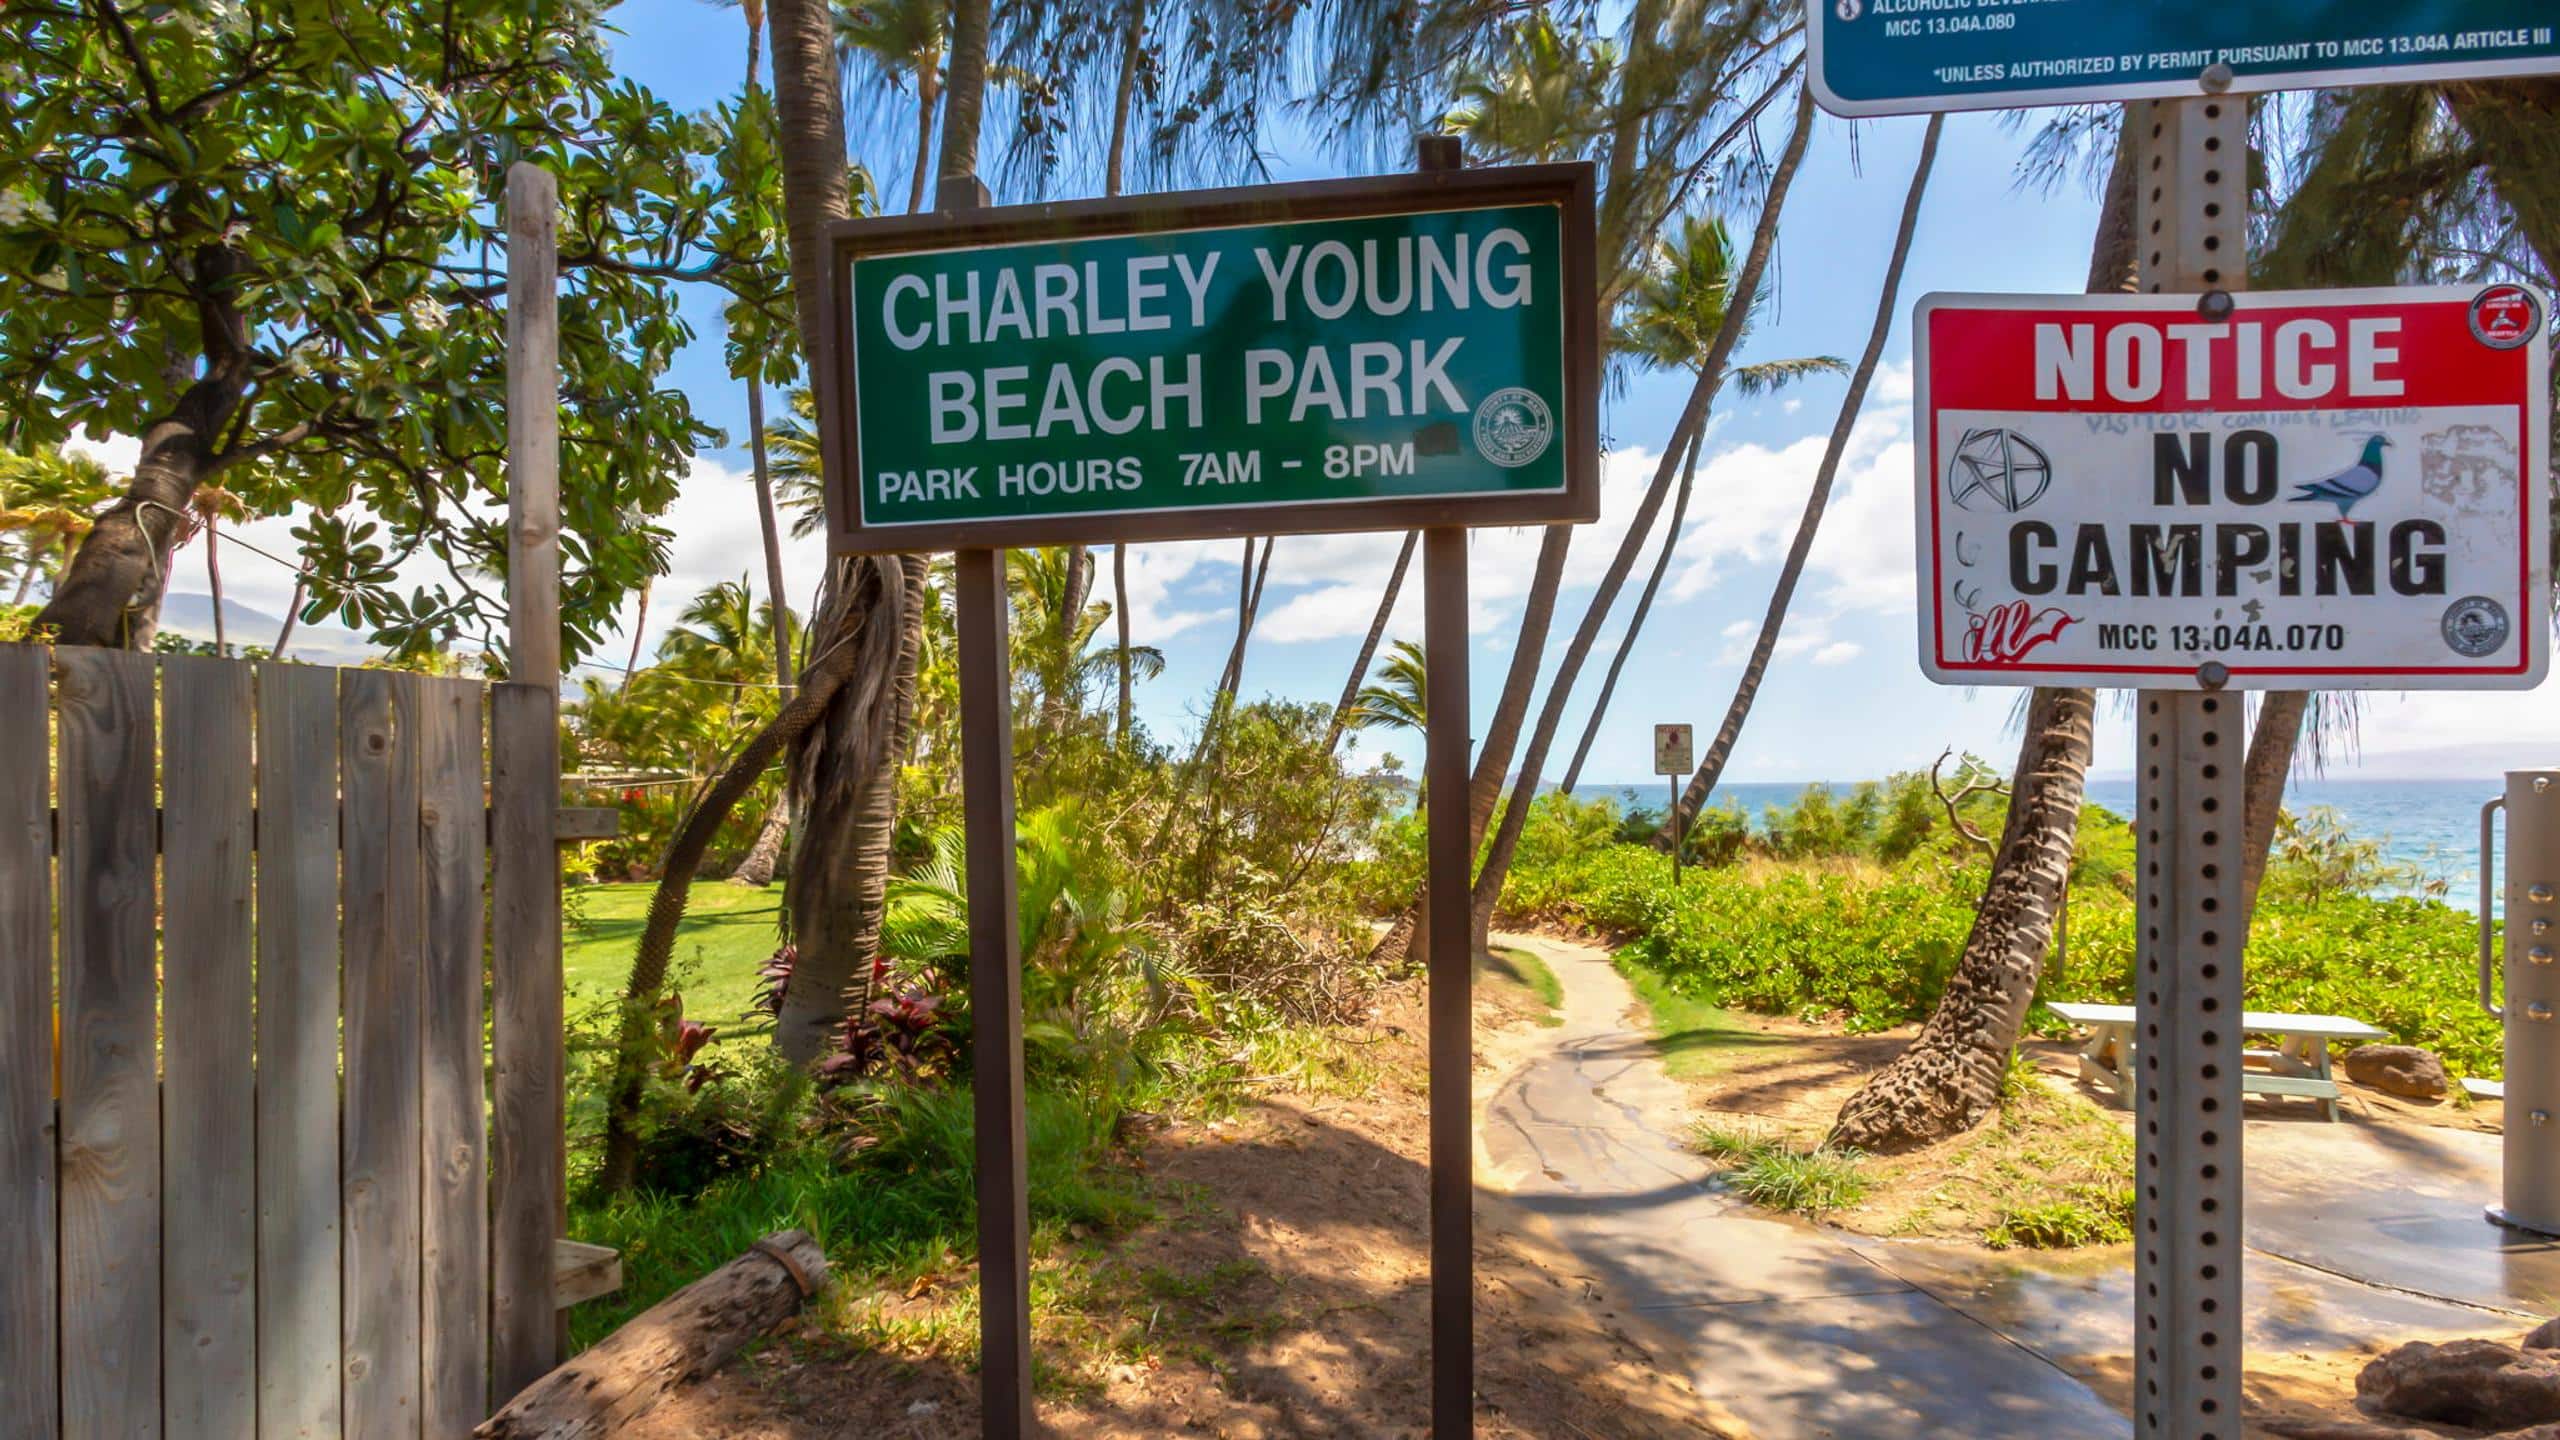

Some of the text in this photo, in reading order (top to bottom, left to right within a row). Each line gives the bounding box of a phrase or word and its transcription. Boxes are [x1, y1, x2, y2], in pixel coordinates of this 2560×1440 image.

[1885, 12, 2016, 37] MCC 13.04A.080
[2009, 56, 2115, 78] AUTHORIZED
[2120, 54, 2143, 71] BY
[2148, 49, 2213, 69] PERMIT
[2217, 42, 2311, 65] PURSUANT
[2315, 41, 2339, 59] TO
[2343, 38, 2384, 56] MCC
[2388, 34, 2449, 54] 13.04A
[2452, 29, 2530, 50] ARTICLE
[2533, 27, 2551, 45] III
[882, 227, 1533, 351] CHARLEY YOUNG
[927, 336, 1470, 445] BEACH PARK
[2034, 317, 2405, 403] NOTICE
[878, 442, 1414, 503] PARK HOURS 7AM - 8PM
[2153, 430, 2279, 506] NO
[2009, 519, 2447, 598] CAMPING
[2098, 624, 2344, 651] MCC 13.04A.070
